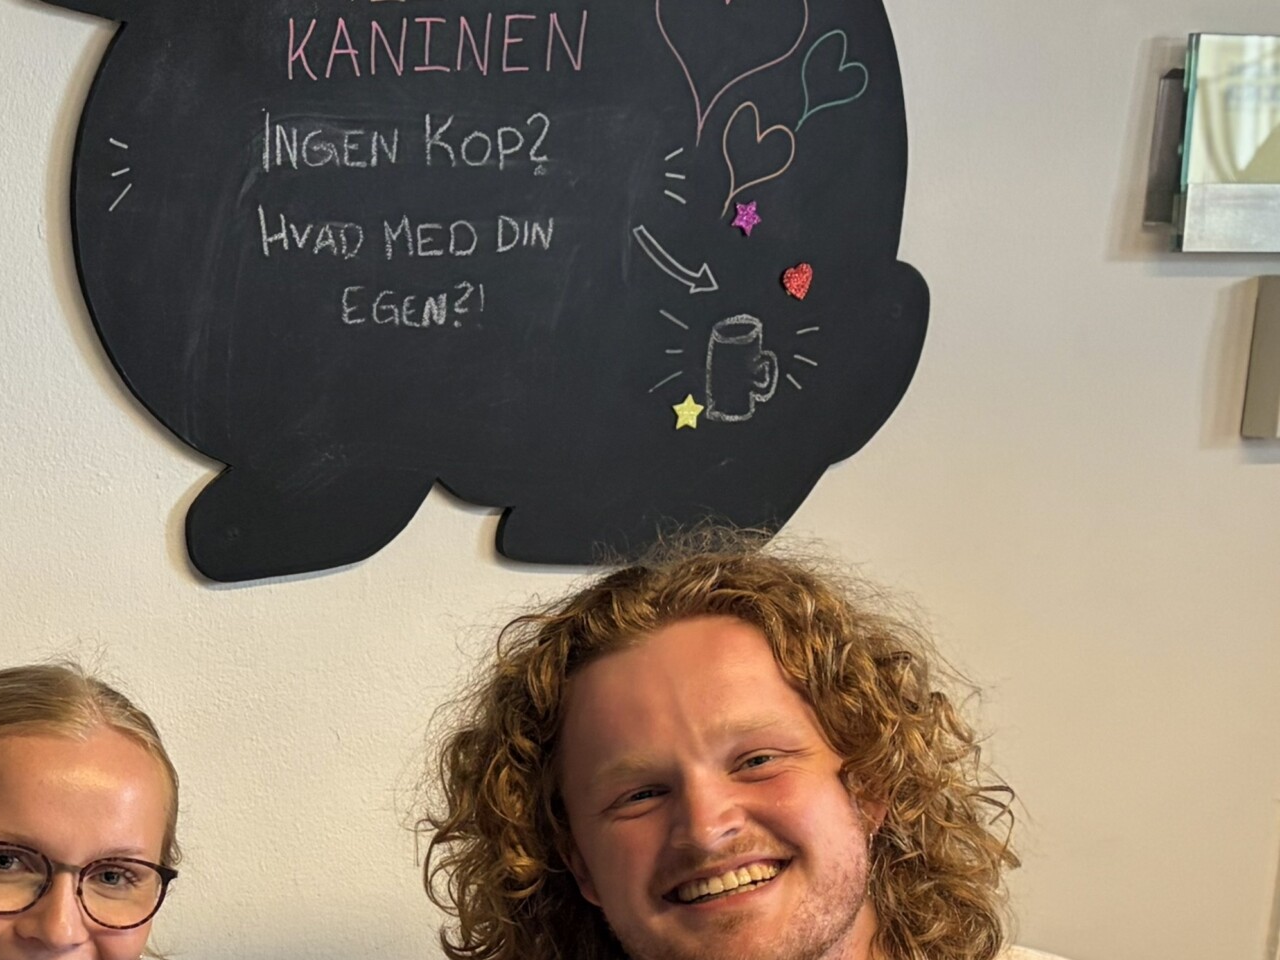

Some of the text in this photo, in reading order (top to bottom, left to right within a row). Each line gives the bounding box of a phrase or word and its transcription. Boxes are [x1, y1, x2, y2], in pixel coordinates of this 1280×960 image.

[288, 10, 587, 80] KANINEN
[262, 111, 550, 176] INGEN KOP?
[258, 204, 554, 260] HVAD MED DIN
